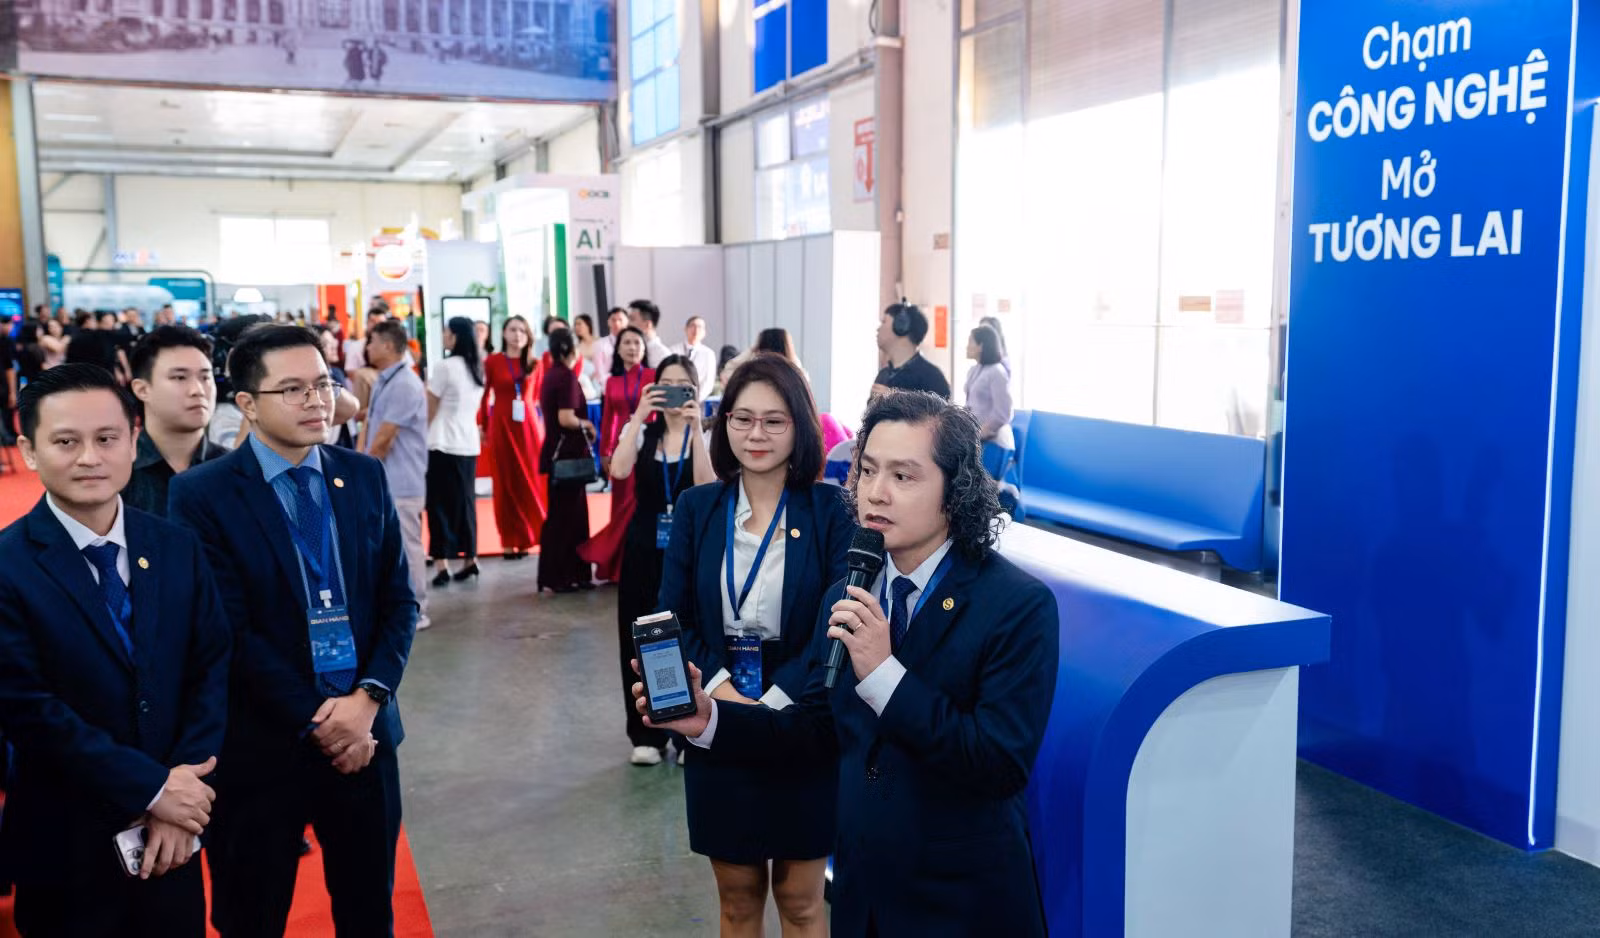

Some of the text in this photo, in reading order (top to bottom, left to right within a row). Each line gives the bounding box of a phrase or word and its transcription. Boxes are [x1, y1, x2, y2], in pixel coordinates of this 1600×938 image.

[1363, 17, 1472, 72] Chạm
[1308, 48, 1549, 142] CÔNG NGHỆ
[1382, 149, 1437, 201] Mở
[577, 229, 602, 249] AI
[1309, 209, 1523, 263] TƯƠNG LAI
